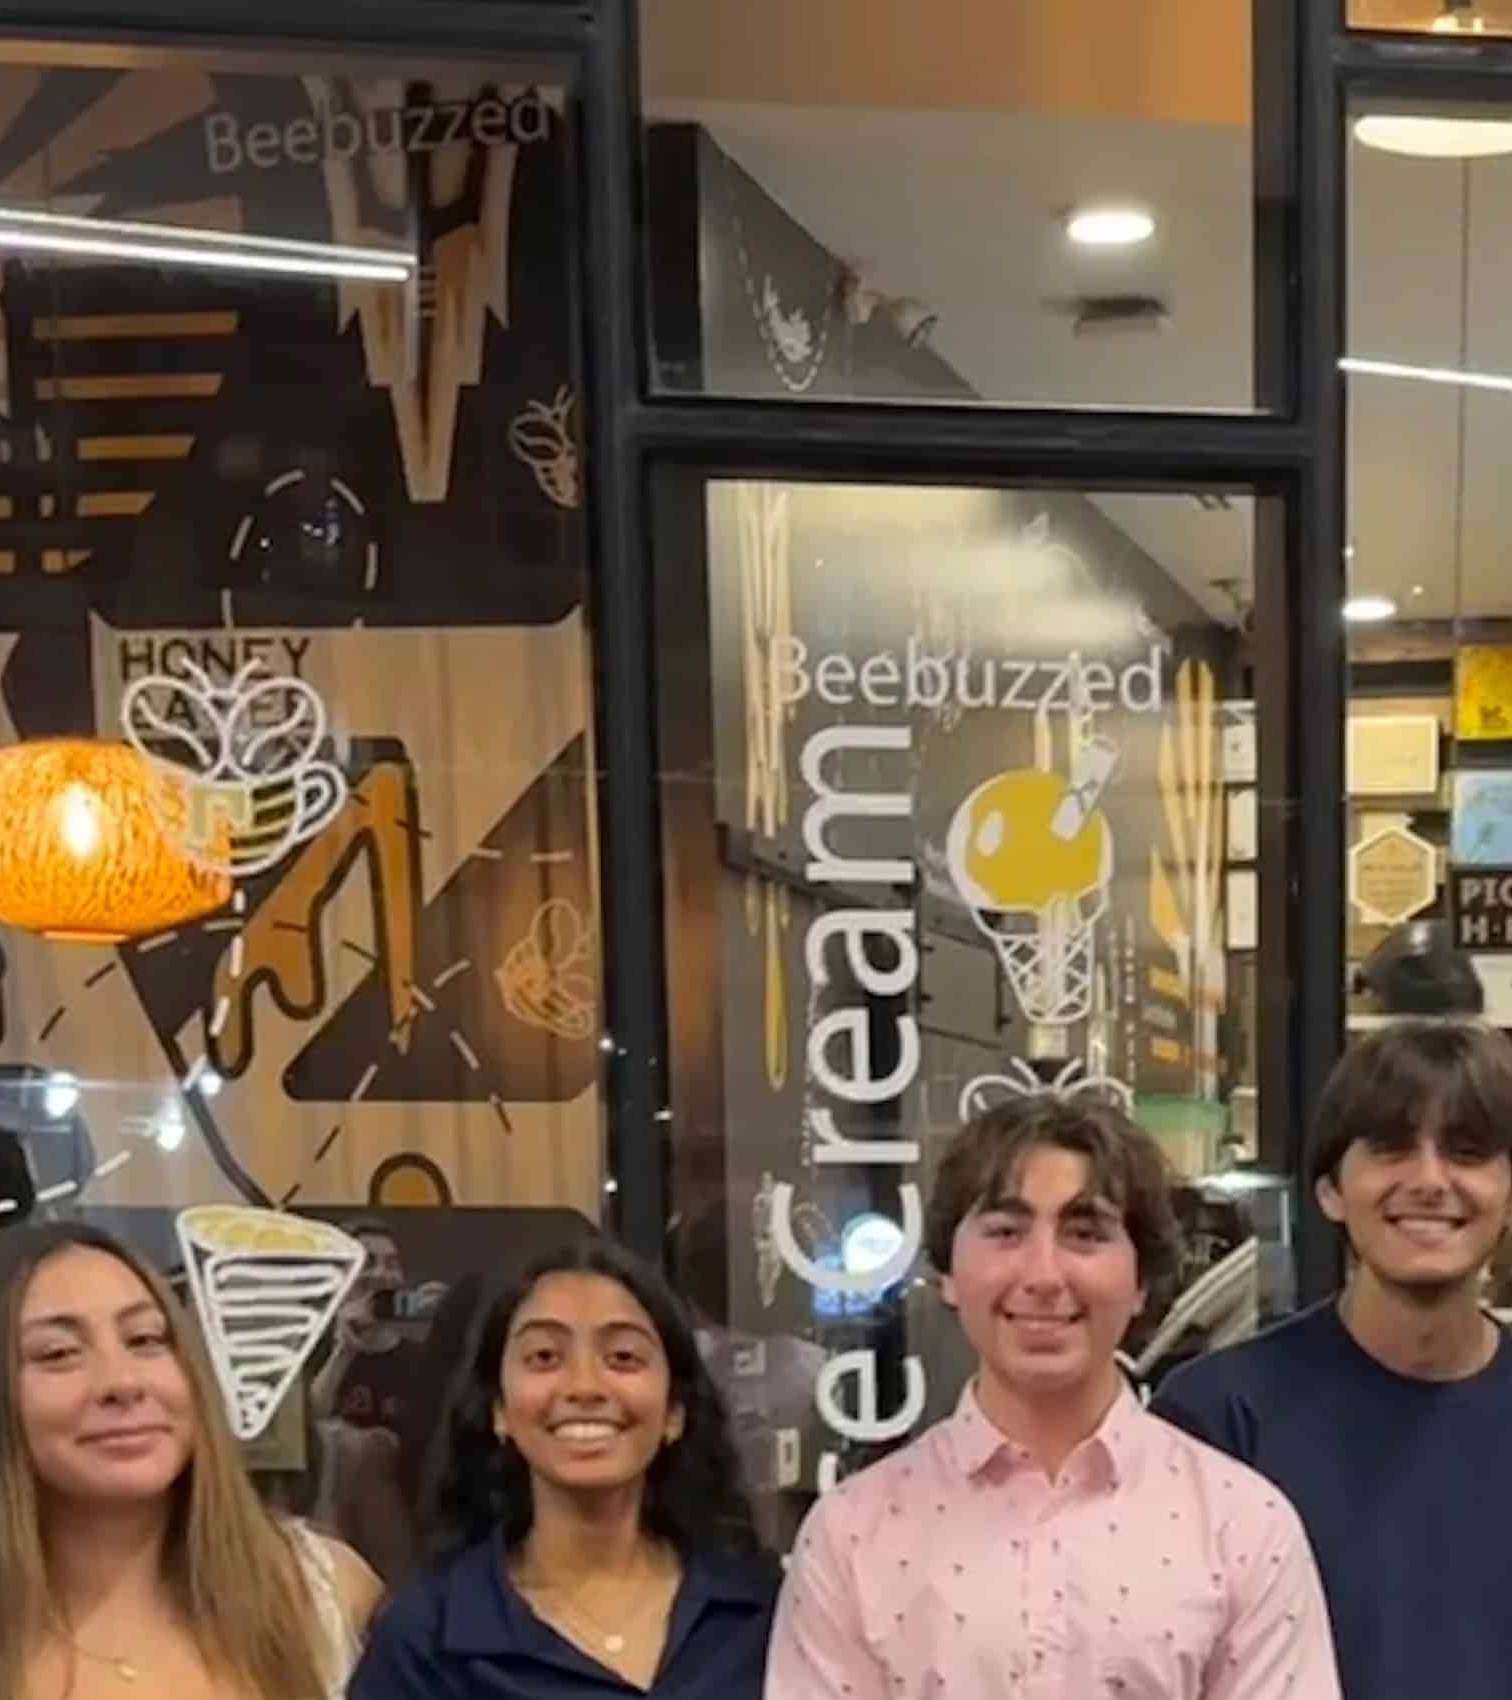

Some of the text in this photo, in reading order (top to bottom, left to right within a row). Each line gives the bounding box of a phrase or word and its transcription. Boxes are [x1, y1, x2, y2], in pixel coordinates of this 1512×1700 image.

[204, 94, 551, 173] Beebuzzed
[772, 636, 1163, 714] Beebuzzed
[770, 726, 922, 1295] Cream
